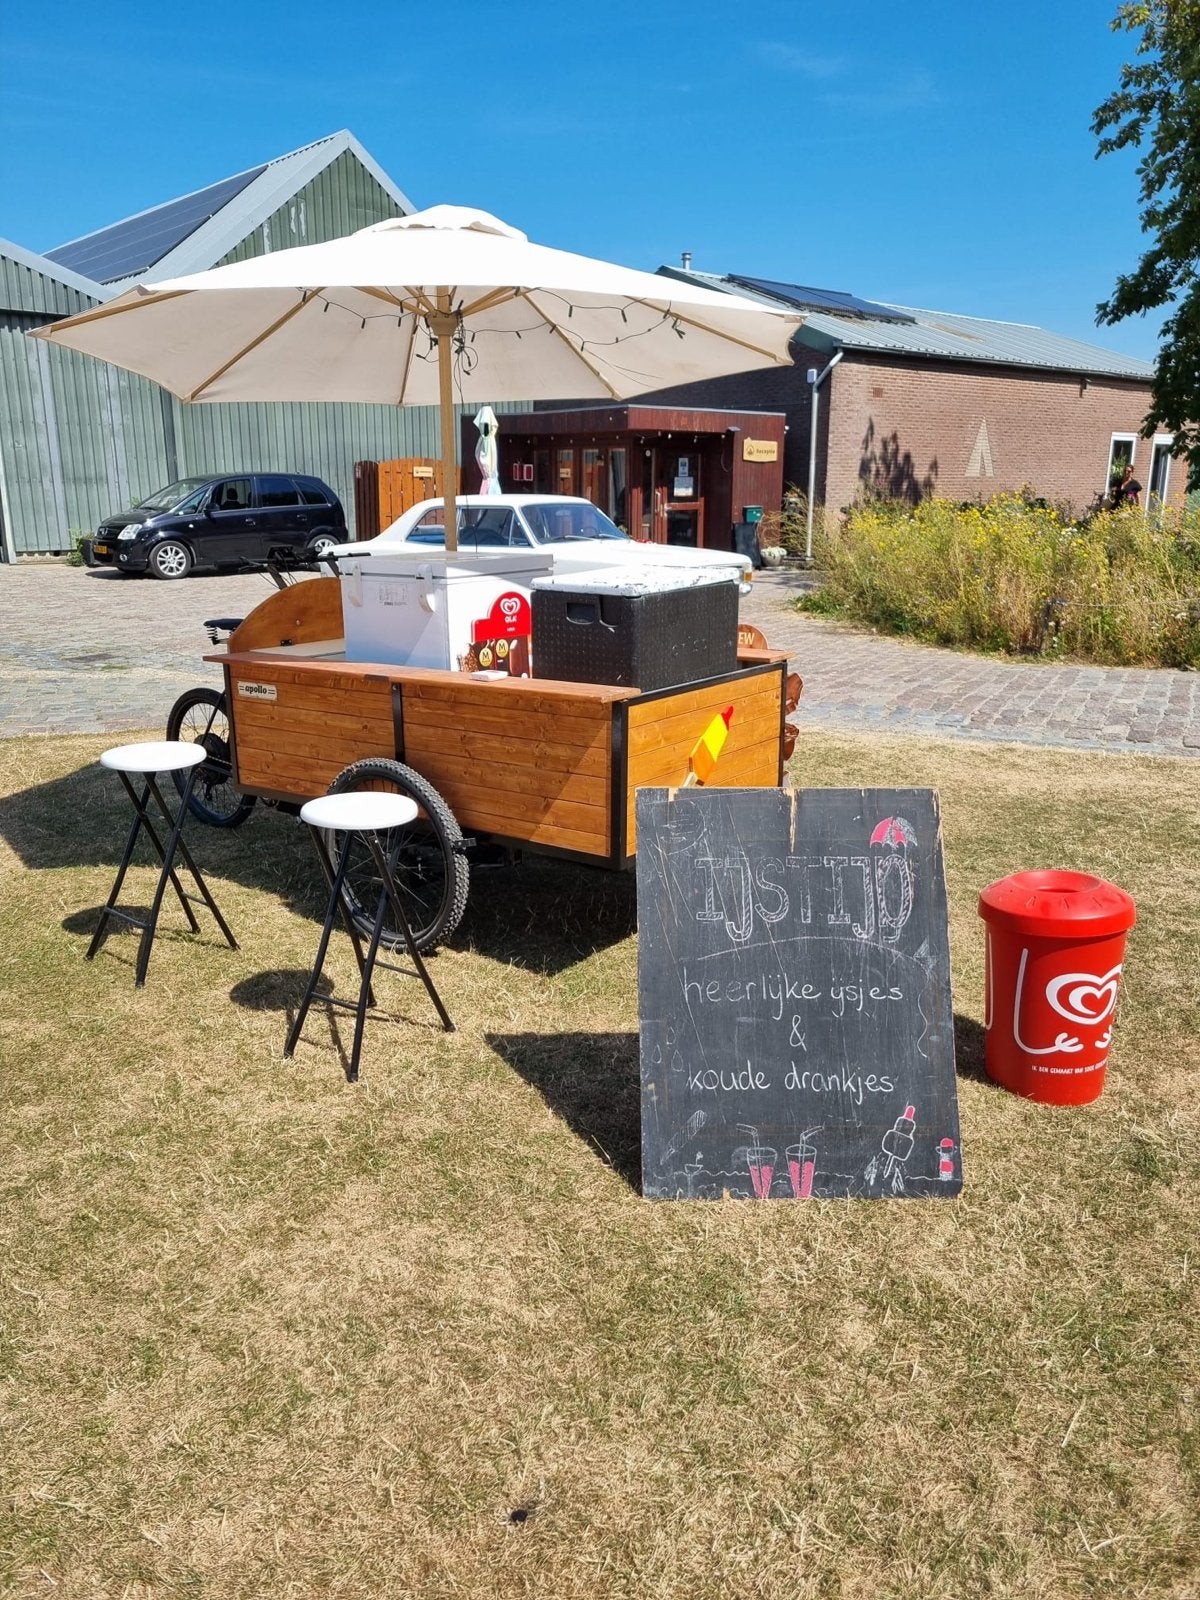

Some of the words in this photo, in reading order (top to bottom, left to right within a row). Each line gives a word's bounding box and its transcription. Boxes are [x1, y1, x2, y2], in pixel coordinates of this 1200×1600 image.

[245, 685, 267, 694] apollo
[683, 967, 821, 1020] heerlijke
[831, 976, 904, 1017] ijsjes
[788, 1014, 807, 1052] &
[686, 1061, 770, 1091] koude
[784, 1061, 896, 1105] drankjes
